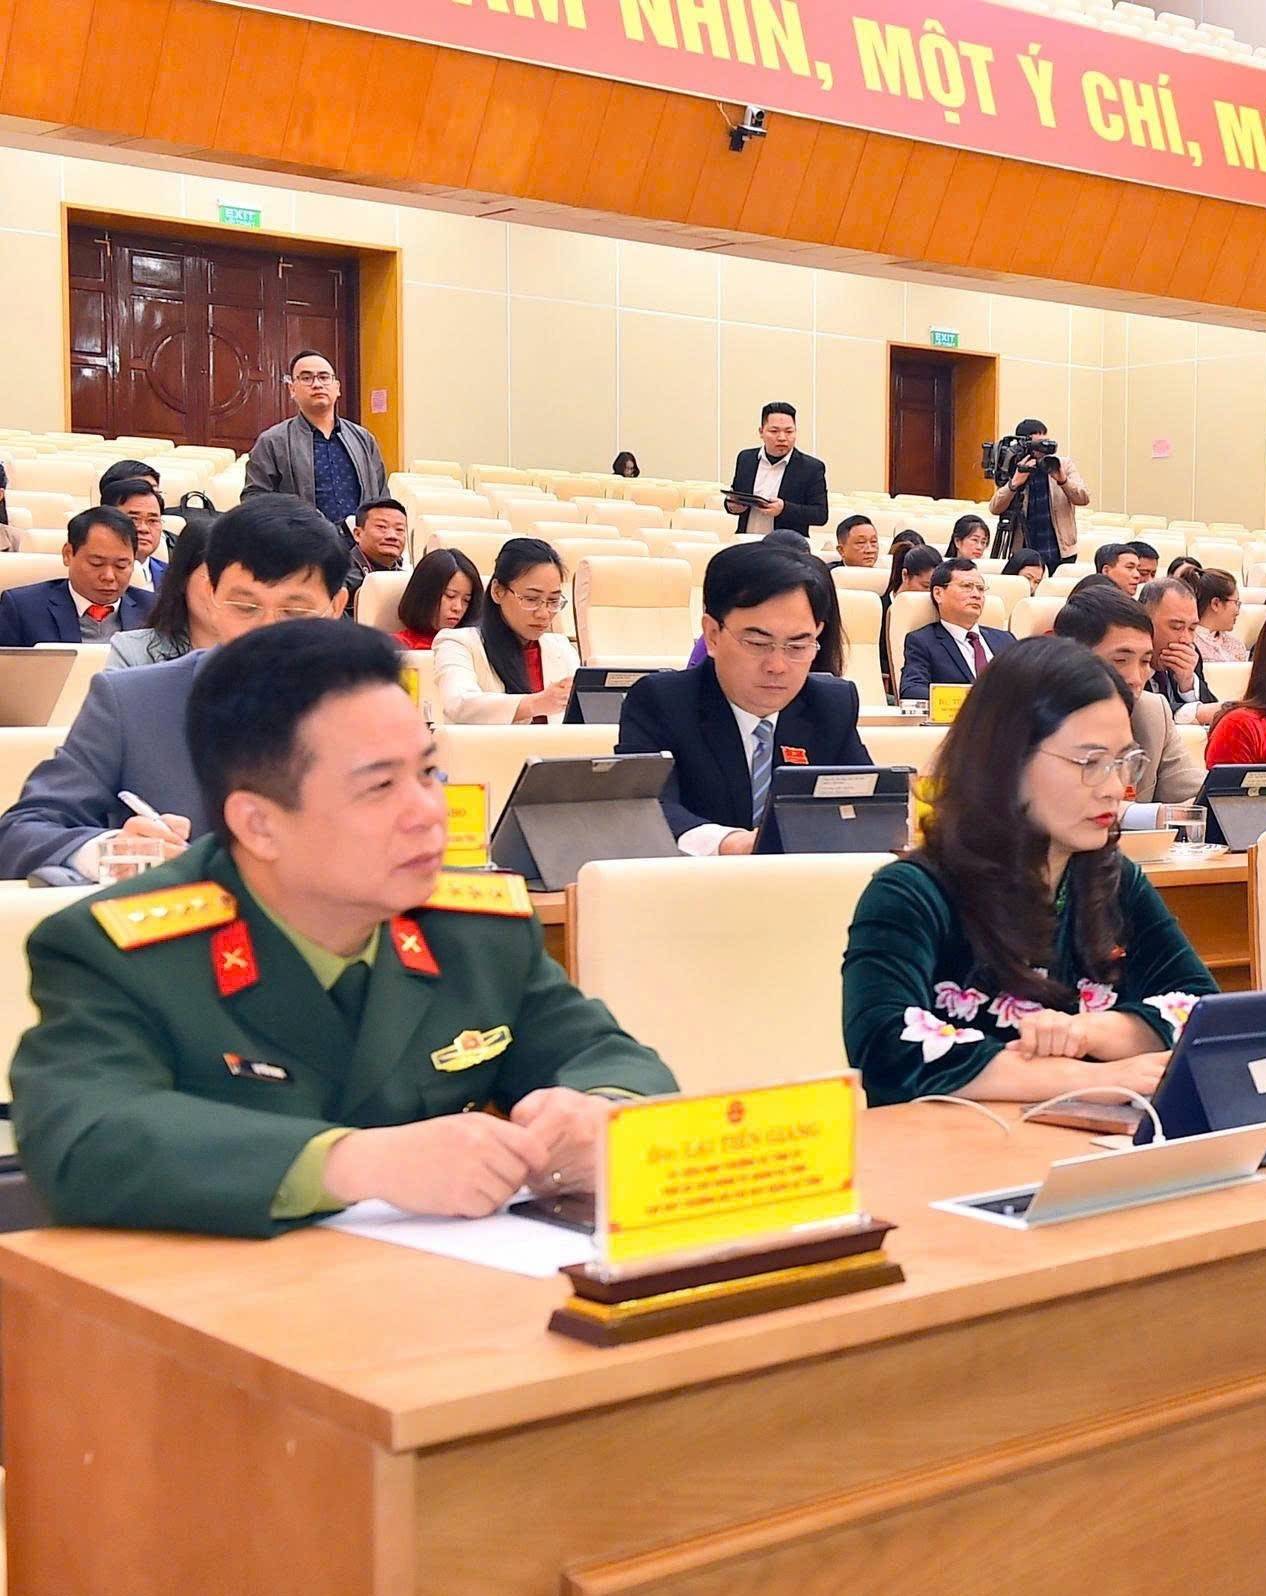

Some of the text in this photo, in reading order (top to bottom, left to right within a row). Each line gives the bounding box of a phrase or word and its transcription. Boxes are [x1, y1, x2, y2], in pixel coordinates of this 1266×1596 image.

[853, 18, 997, 124] MỘT
[1019, 44, 1057, 129] Ý
[1082, 71, 1203, 167] CHÍ,
[225, 208, 257, 222] EXIT
[935, 333, 956, 345] EXIT
